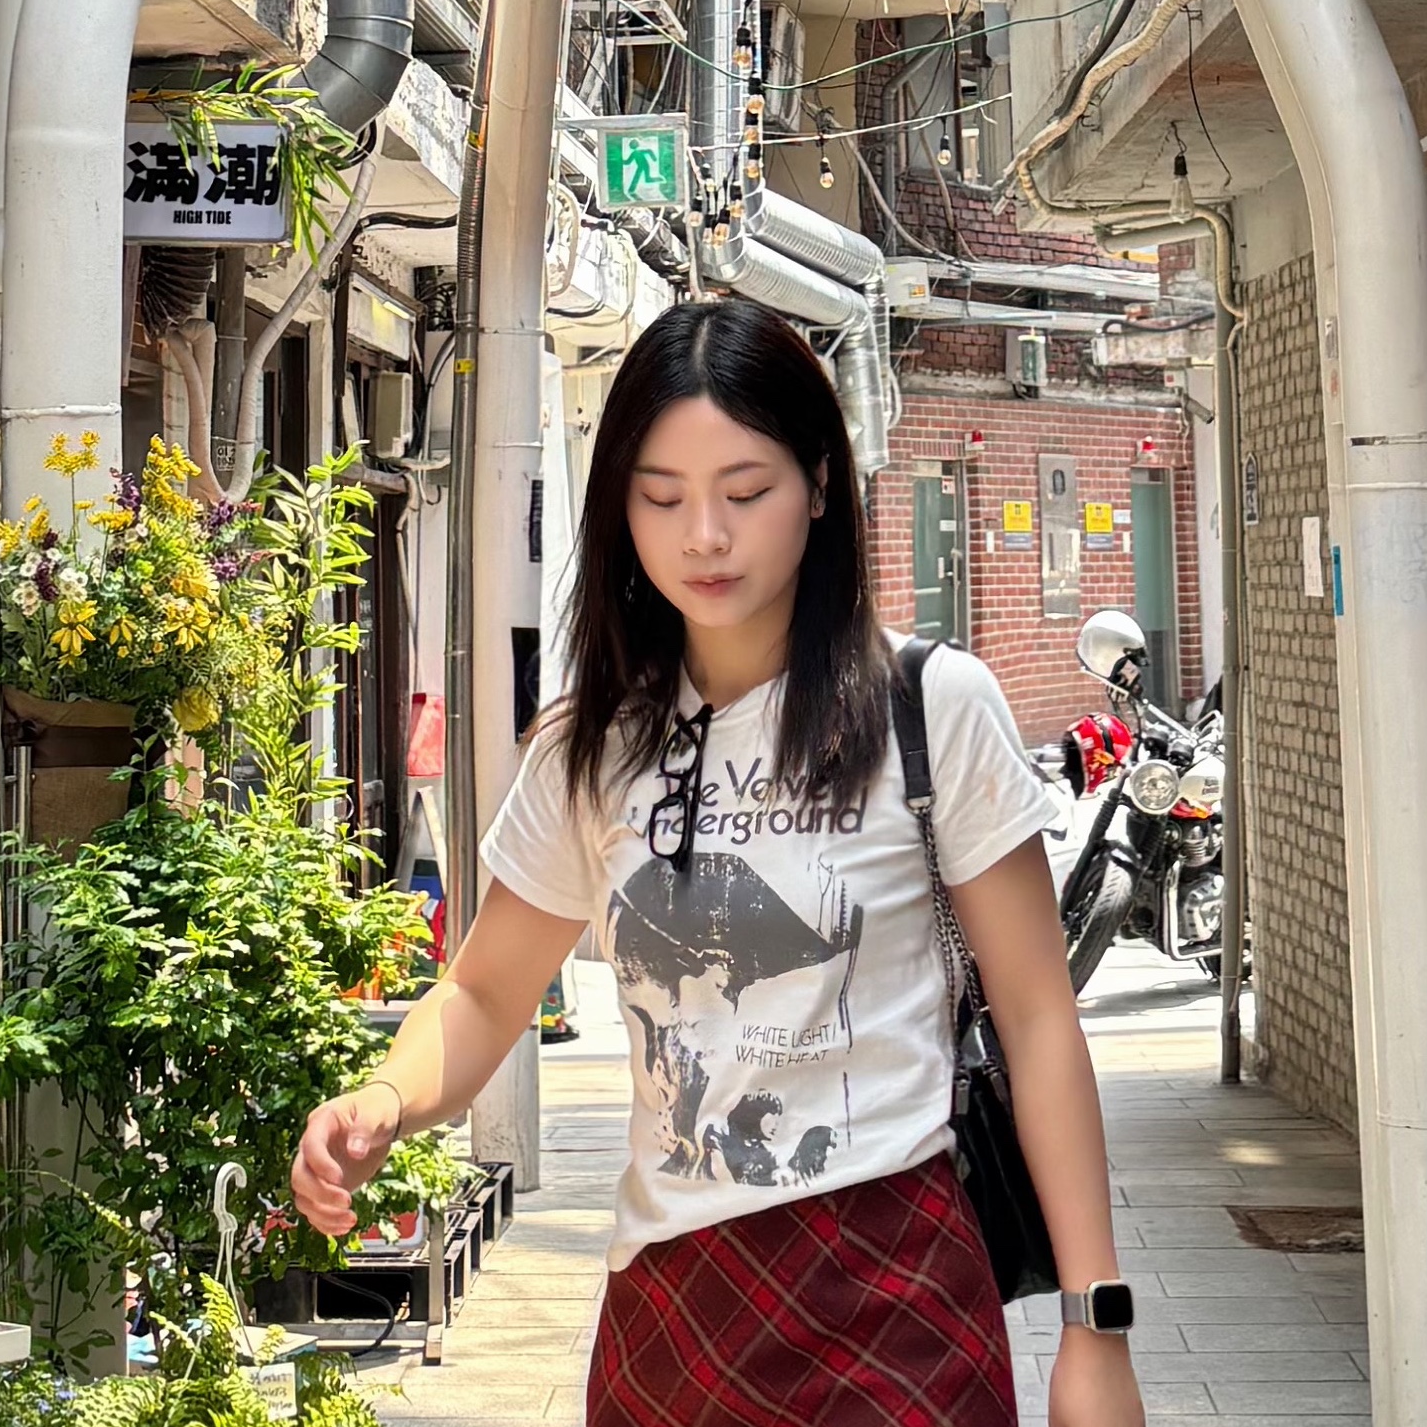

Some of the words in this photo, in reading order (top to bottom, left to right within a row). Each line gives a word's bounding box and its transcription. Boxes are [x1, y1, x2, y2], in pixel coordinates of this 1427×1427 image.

[173, 209, 203, 225] HIGH
[205, 210, 232, 225] TIDE
[742, 1024, 788, 1047] WHITE
[735, 1044, 786, 1069] WHITE
